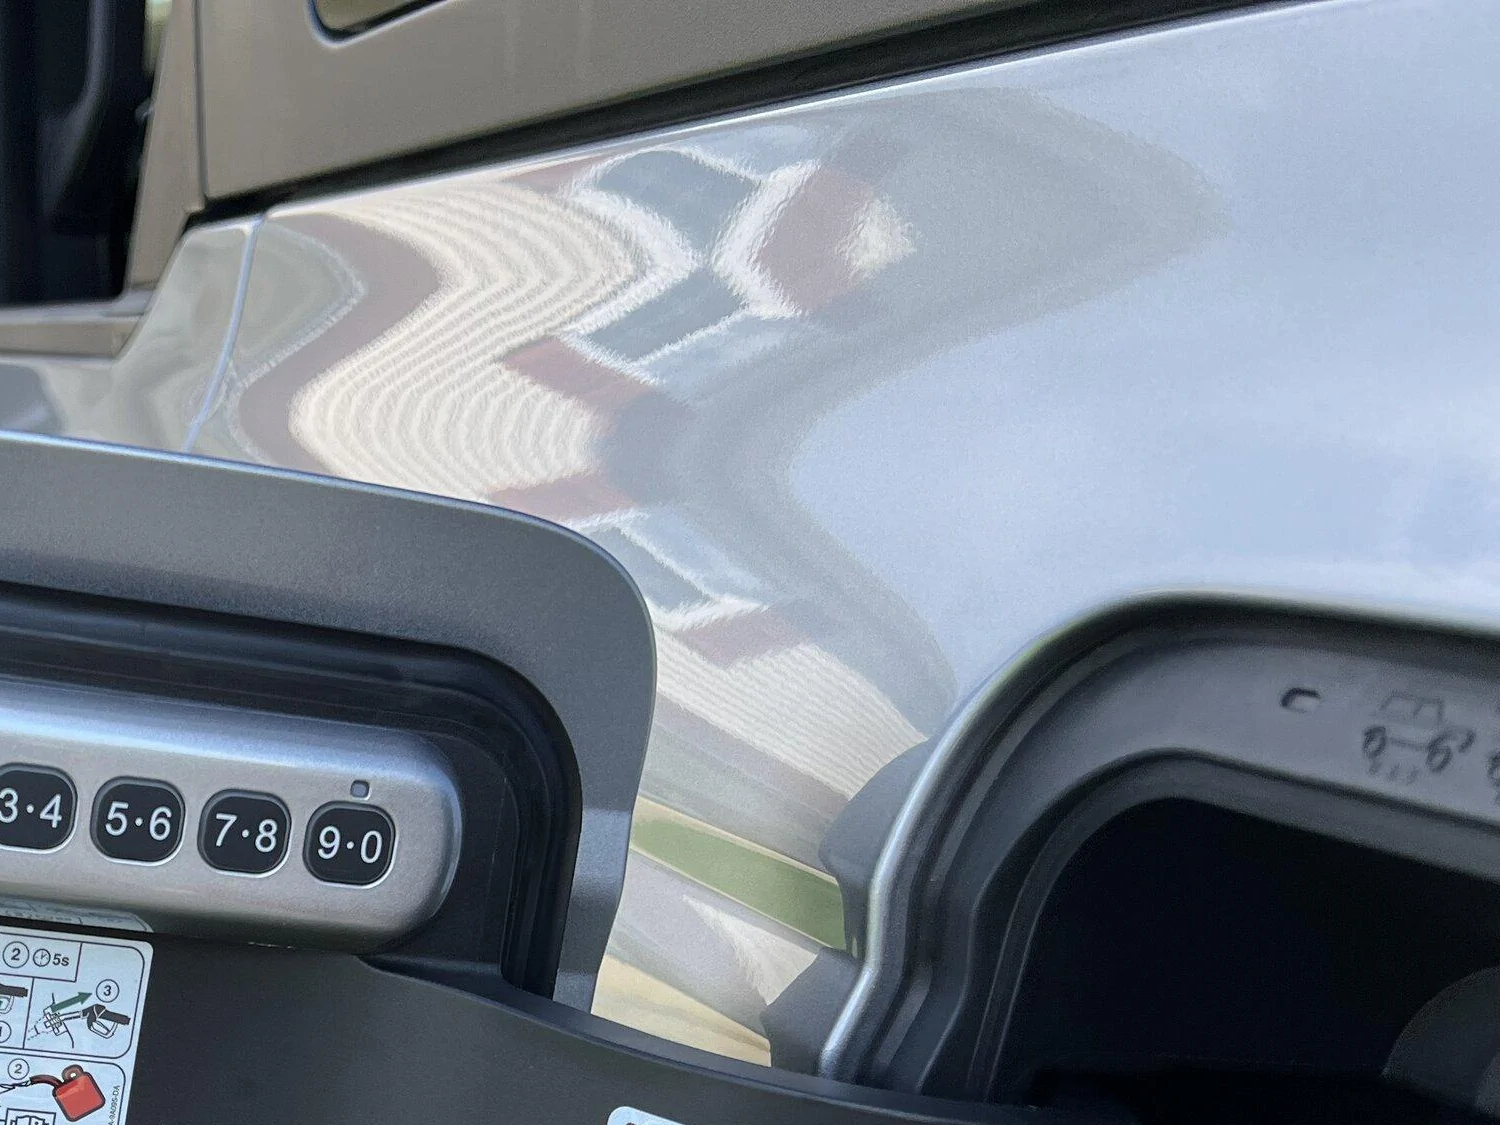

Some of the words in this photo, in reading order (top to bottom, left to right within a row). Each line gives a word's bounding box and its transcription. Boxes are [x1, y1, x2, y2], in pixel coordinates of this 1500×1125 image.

[10, 947, 21, 961] 2
[52, 953, 70, 967] 5s
[103, 984, 112, 997] 3
[14, 1063, 23, 1074] 2
